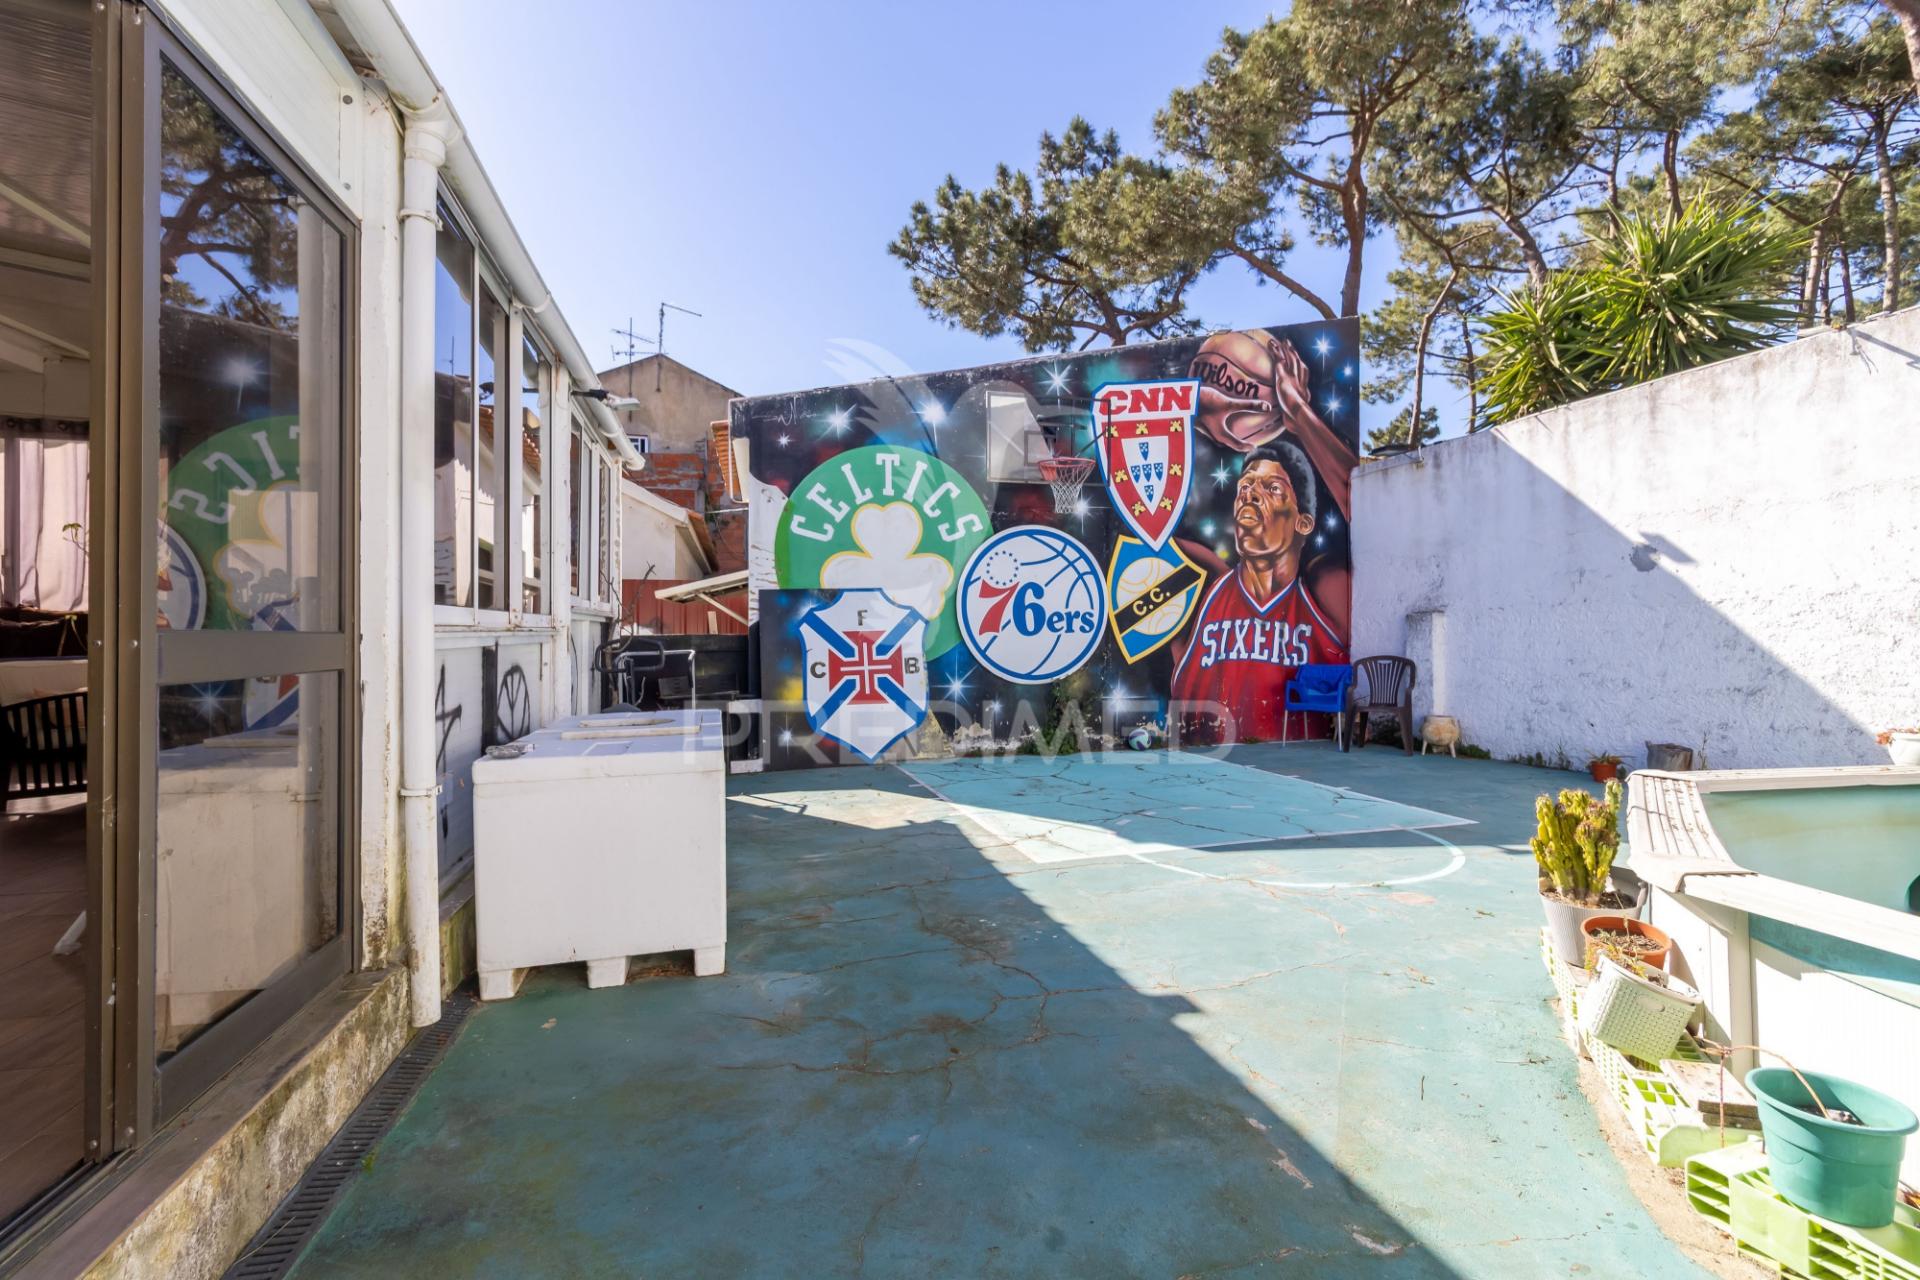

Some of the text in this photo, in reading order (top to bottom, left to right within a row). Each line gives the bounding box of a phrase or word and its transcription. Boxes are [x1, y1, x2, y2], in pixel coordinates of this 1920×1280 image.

[1193, 360, 1260, 400] Wilson
[1099, 385, 1193, 416] CNN
[789, 452, 984, 542] CELTICS
[857, 609, 868, 626] F
[978, 579, 1096, 637] 76ers
[1200, 616, 1313, 668] SIXERS
[810, 657, 920, 679] C B
